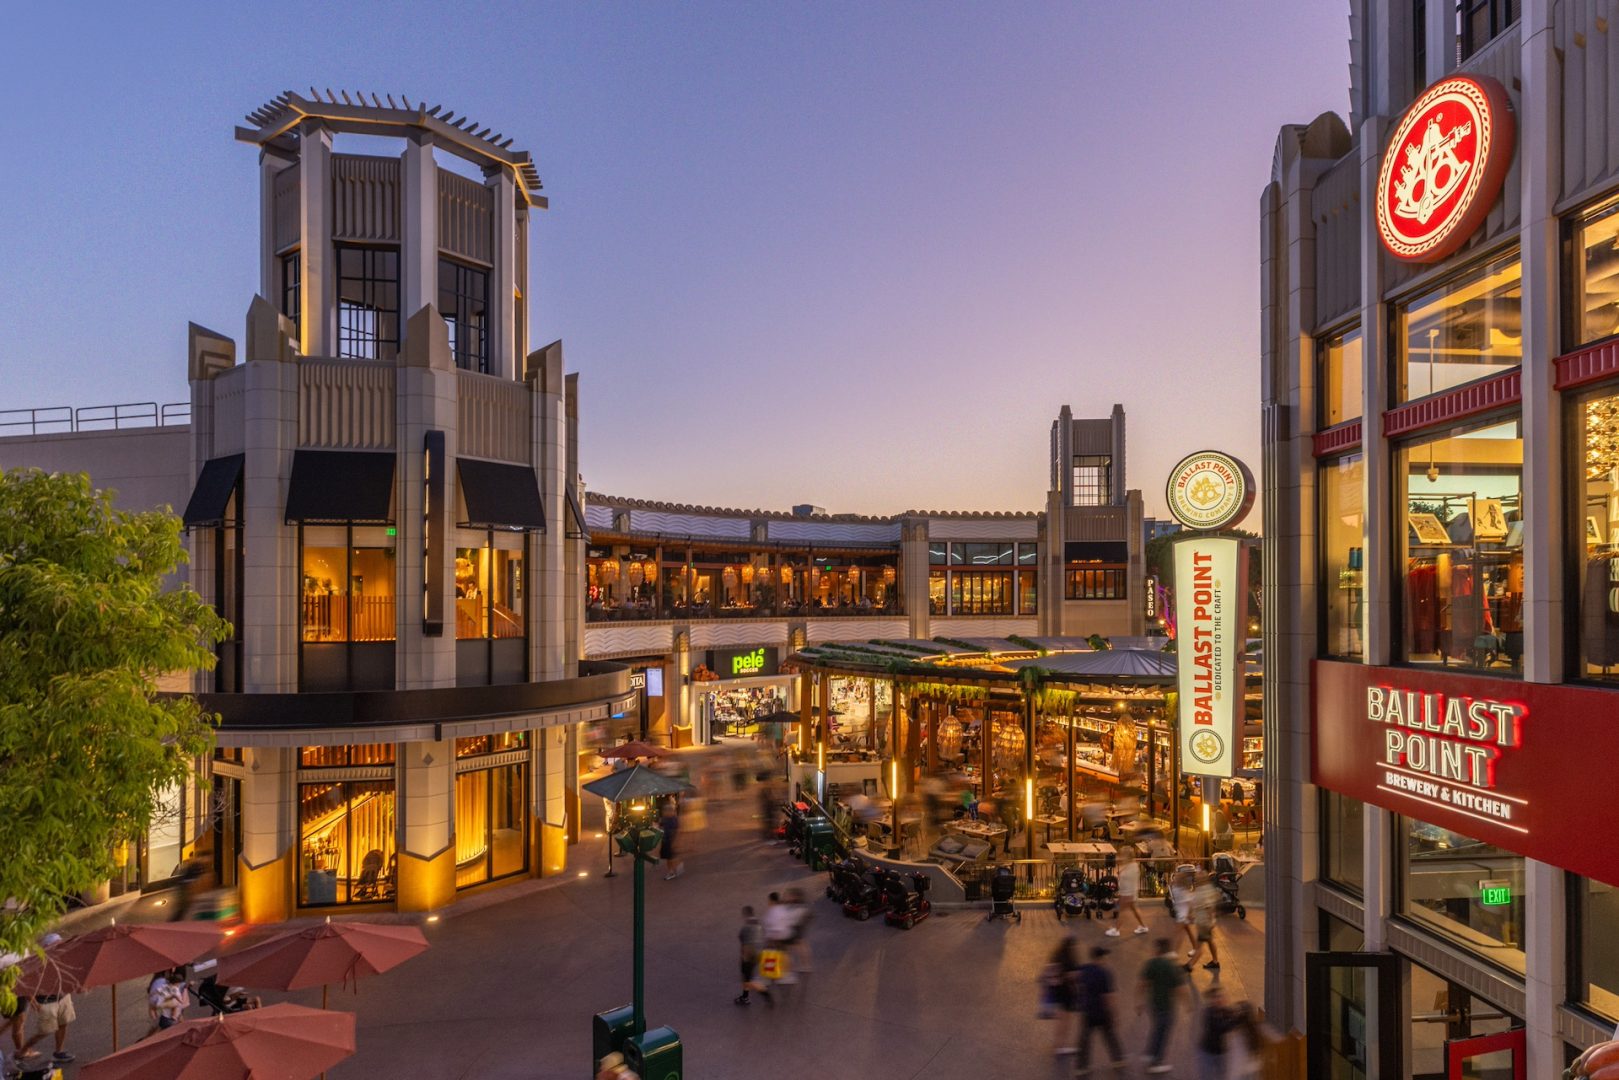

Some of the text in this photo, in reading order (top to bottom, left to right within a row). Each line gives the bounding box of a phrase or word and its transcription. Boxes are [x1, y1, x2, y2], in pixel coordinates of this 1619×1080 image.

[1178, 462, 1235, 489] BALLAST POINT
[1178, 493, 1234, 519] BREWING COMPANY
[1214, 589, 1222, 614] CRAFT
[1193, 551, 1213, 726] BALLAST POINT
[1215, 633, 1222, 644] TO
[1367, 686, 1515, 746] BALLAST
[1386, 728, 1488, 786] POINT
[1386, 771, 1511, 819] BREWERY & KITCHEN
[1488, 888, 1506, 903] EXIT
